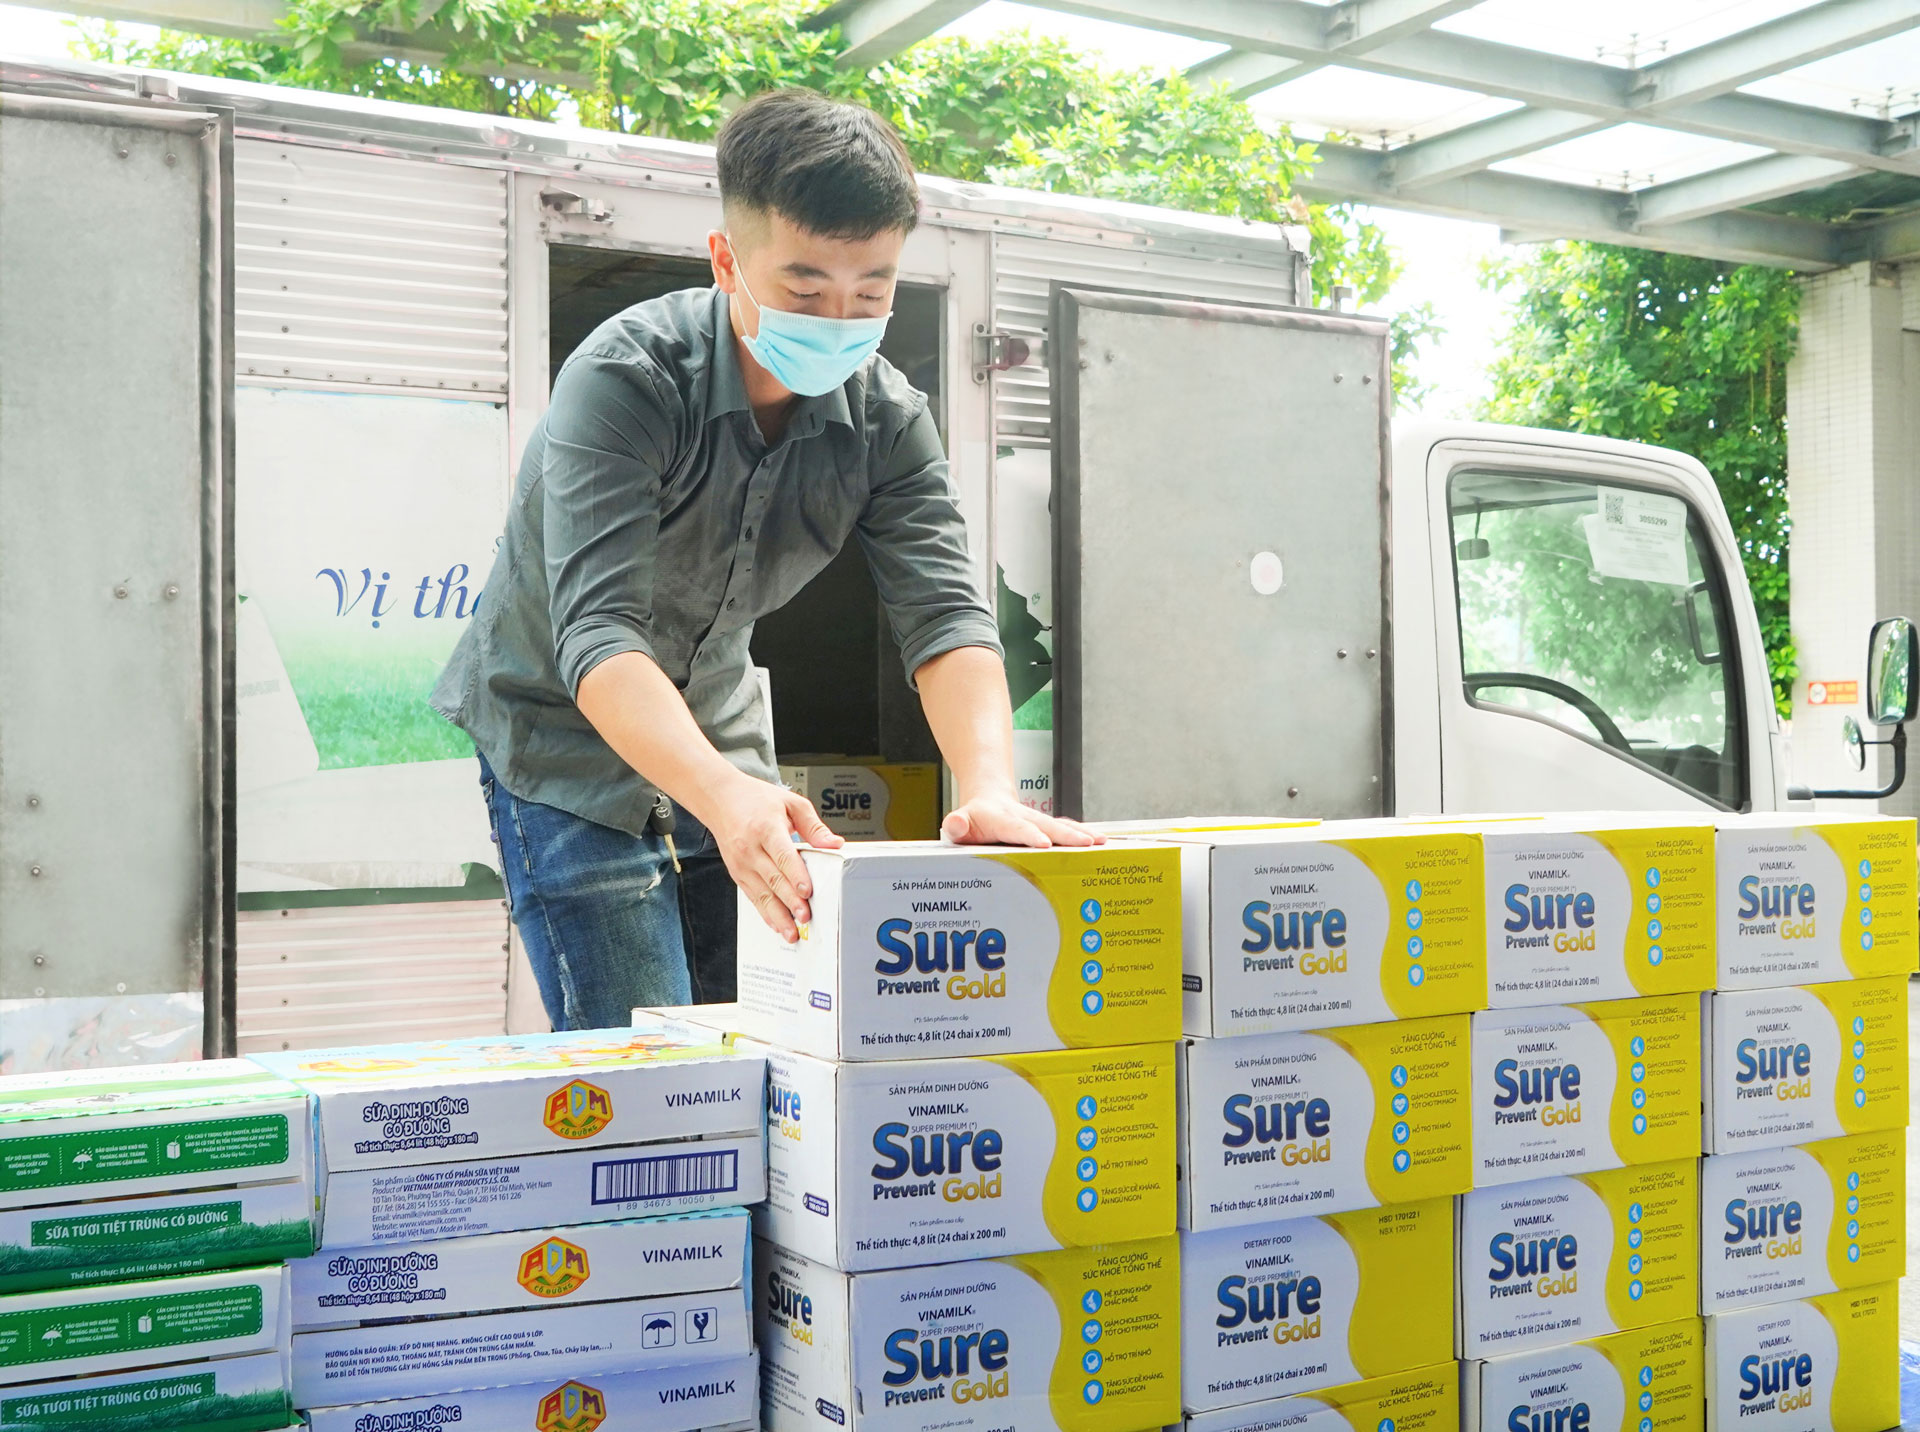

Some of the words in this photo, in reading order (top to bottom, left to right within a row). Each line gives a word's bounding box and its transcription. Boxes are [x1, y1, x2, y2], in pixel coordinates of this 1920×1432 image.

[315, 567, 398, 629] Vị
[1020, 775, 1048, 790] mới
[820, 788, 871, 810] Sure
[848, 810, 871, 820] Gold
[1096, 866, 1118, 875] TĂNG
[1119, 864, 1149, 874] CƯỜNG
[1528, 870, 1568, 880] VINAMILK
[1759, 861, 1793, 871] VINAMILK
[893, 880, 909, 892] SẢN
[911, 878, 936, 891] PHẨM
[938, 879, 959, 890] DINH
[961, 878, 992, 889] DƯỠNG
[1081, 877, 1097, 887] SỨC
[1123, 874, 1146, 884] TỔNG
[1148, 872, 1163, 883] THỂ
[1270, 885, 1315, 895] VINAMILK
[912, 901, 968, 913] VINAMILK
[1504, 884, 1595, 932] Sure
[1738, 875, 1815, 920] Sure
[915, 921, 937, 929] SUPER
[940, 920, 970, 929] PREMIUM
[1242, 900, 1347, 954] Sure
[1739, 922, 1776, 936] Prevent
[1780, 918, 1815, 940] Gold
[875, 918, 1006, 976] Sure
[1506, 934, 1549, 949] Prevent
[1554, 930, 1595, 953] Gold
[1243, 955, 1294, 973] Prevent
[1299, 949, 1347, 976] Gold
[877, 978, 940, 996] Prevent
[946, 972, 1006, 1000] Gold
[861, 1032, 876, 1045] Thể
[878, 1033, 893, 1045] tích
[895, 1033, 916, 1046] thực:
[918, 1031, 930, 1044] 4,8
[932, 1030, 940, 1041] lít
[943, 1029, 955, 1042] (24
[956, 1028, 973, 1039] chai
[981, 1027, 996, 1038] 200
[998, 1026, 1011, 1038] ml)
[1757, 1023, 1789, 1033] VINAMILK
[1517, 1043, 1555, 1054] VINAMILK
[1736, 1038, 1811, 1084] Sure
[1251, 1074, 1298, 1088] VINAMILK
[1494, 1059, 1580, 1108] Sure
[1737, 1085, 1773, 1099] Prevent
[1777, 1078, 1811, 1101] Gold
[390, 1102, 422, 1120] DINH
[423, 1097, 469, 1116] DƯỠNG
[550, 1085, 607, 1121] ADM
[665, 1087, 741, 1108] VINAMILK
[908, 1103, 965, 1117] VINAMILK
[1222, 1093, 1330, 1148] Sure
[1495, 1108, 1537, 1125] Prevent
[1541, 1102, 1581, 1127] Gold
[383, 1117, 404, 1138] CÓ
[404, 1117, 450, 1136] ĐƯỜNG
[871, 1122, 1003, 1180] Sure
[1224, 1148, 1276, 1166] Prevent
[1281, 1139, 1330, 1167] Gold
[372, 1178, 384, 1186] Sản
[385, 1176, 403, 1186] phẩm
[404, 1176, 415, 1184] của
[416, 1173, 434, 1182] CÔNG
[435, 1172, 444, 1180] TY
[445, 1170, 454, 1179] CỔ
[455, 1168, 474, 1179] PHẦN
[475, 1167, 488, 1177] SỮA
[489, 1167, 503, 1178] VIỆT
[504, 1166, 520, 1174] NAM
[403, 1183, 433, 1192] VIETNAM
[433, 1181, 453, 1189] DAIRY
[454, 1178, 489, 1188] PRODUCTS
[500, 1176, 509, 1184] CO.
[873, 1180, 936, 1201] Prevent
[942, 1174, 1002, 1203] Gold
[1746, 1183, 1780, 1194] VINAMILK
[626, 1201, 637, 1210] 89
[643, 1198, 672, 1209] 34673
[678, 1195, 705, 1206] 10050
[709, 1194, 715, 1202] 9
[45, 1226, 69, 1241] SỮA
[72, 1224, 98, 1239] TƯƠI
[101, 1219, 127, 1238] TIỆT
[130, 1214, 168, 1232] TRÙNG
[171, 1213, 185, 1228] CÓ
[187, 1208, 229, 1227] ĐƯỜNG
[372, 1213, 391, 1222] Email:
[372, 1223, 398, 1231] Website:
[1514, 1214, 1552, 1227] VINAMILK
[1724, 1199, 1802, 1244] Sure
[642, 1244, 723, 1264] VINAMILK
[1243, 1237, 1271, 1250] DIETARY
[1272, 1235, 1292, 1246] FOOD
[1725, 1242, 1762, 1260] Prevent
[1766, 1235, 1802, 1260] Gold
[358, 1256, 390, 1274] DINH
[390, 1252, 438, 1271] DƯỠNG
[524, 1242, 585, 1278] ADM
[1245, 1254, 1291, 1269] VINAMILK
[1489, 1232, 1578, 1282] Sure
[348, 1274, 370, 1293] CÓ
[370, 1271, 418, 1292] ĐƯỜNG
[1490, 1281, 1532, 1299] Prevent
[1537, 1271, 1577, 1298] Gold
[768, 1271, 813, 1320] Sure
[1216, 1275, 1321, 1329] Sure
[918, 1308, 973, 1322] VINAMILK
[790, 1320, 813, 1347] Gold
[1218, 1326, 1269, 1348] Prevent
[1273, 1315, 1321, 1345] Gold
[1759, 1335, 1791, 1350] VINAMILK
[882, 1328, 1009, 1387] Sure
[1739, 1353, 1812, 1401] Sure
[15, 1402, 40, 1419] SỮA
[42, 1398, 70, 1417] TƯƠI
[74, 1393, 98, 1414] TIỆT
[101, 1389, 140, 1407] TRÙNG
[143, 1385, 157, 1403] CÓ
[159, 1381, 202, 1400] ĐƯỜNG
[658, 1380, 736, 1405] VINAMILK
[885, 1383, 945, 1408] Prevent
[951, 1371, 1009, 1404] Gold
[1530, 1384, 1567, 1399] VINAMILK
[542, 1385, 600, 1421] ADM
[1740, 1397, 1775, 1417] Prevent
[1779, 1386, 1811, 1416] Gold
[1508, 1402, 1590, 1432] Sure
